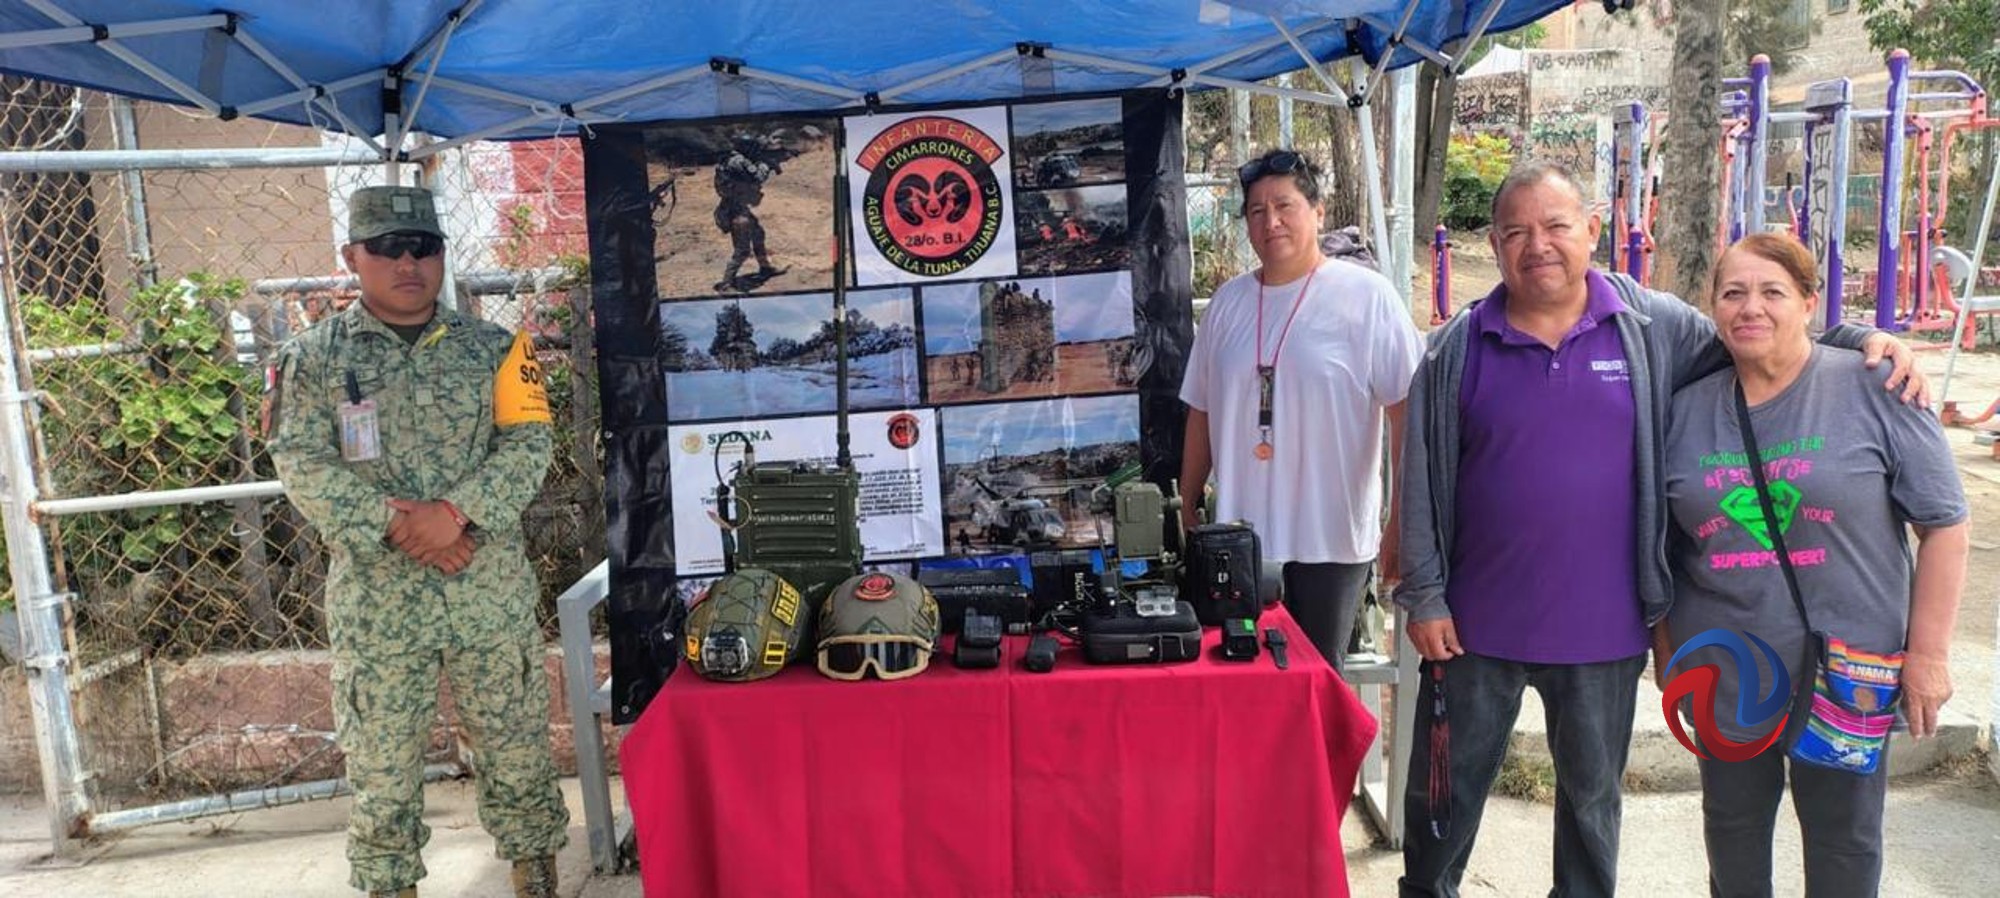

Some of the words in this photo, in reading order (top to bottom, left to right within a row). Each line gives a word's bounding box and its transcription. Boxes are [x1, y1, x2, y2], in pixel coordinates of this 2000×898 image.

[868, 122, 995, 163] INFANTERIA
[885, 142, 974, 170] CIMARRONES
[866, 196, 886, 248] AGUAJE
[886, 246, 905, 263] DE
[903, 257, 919, 273] LA
[964, 211, 998, 262] TIJUANA
[1802, 507, 1835, 525] YOUR
